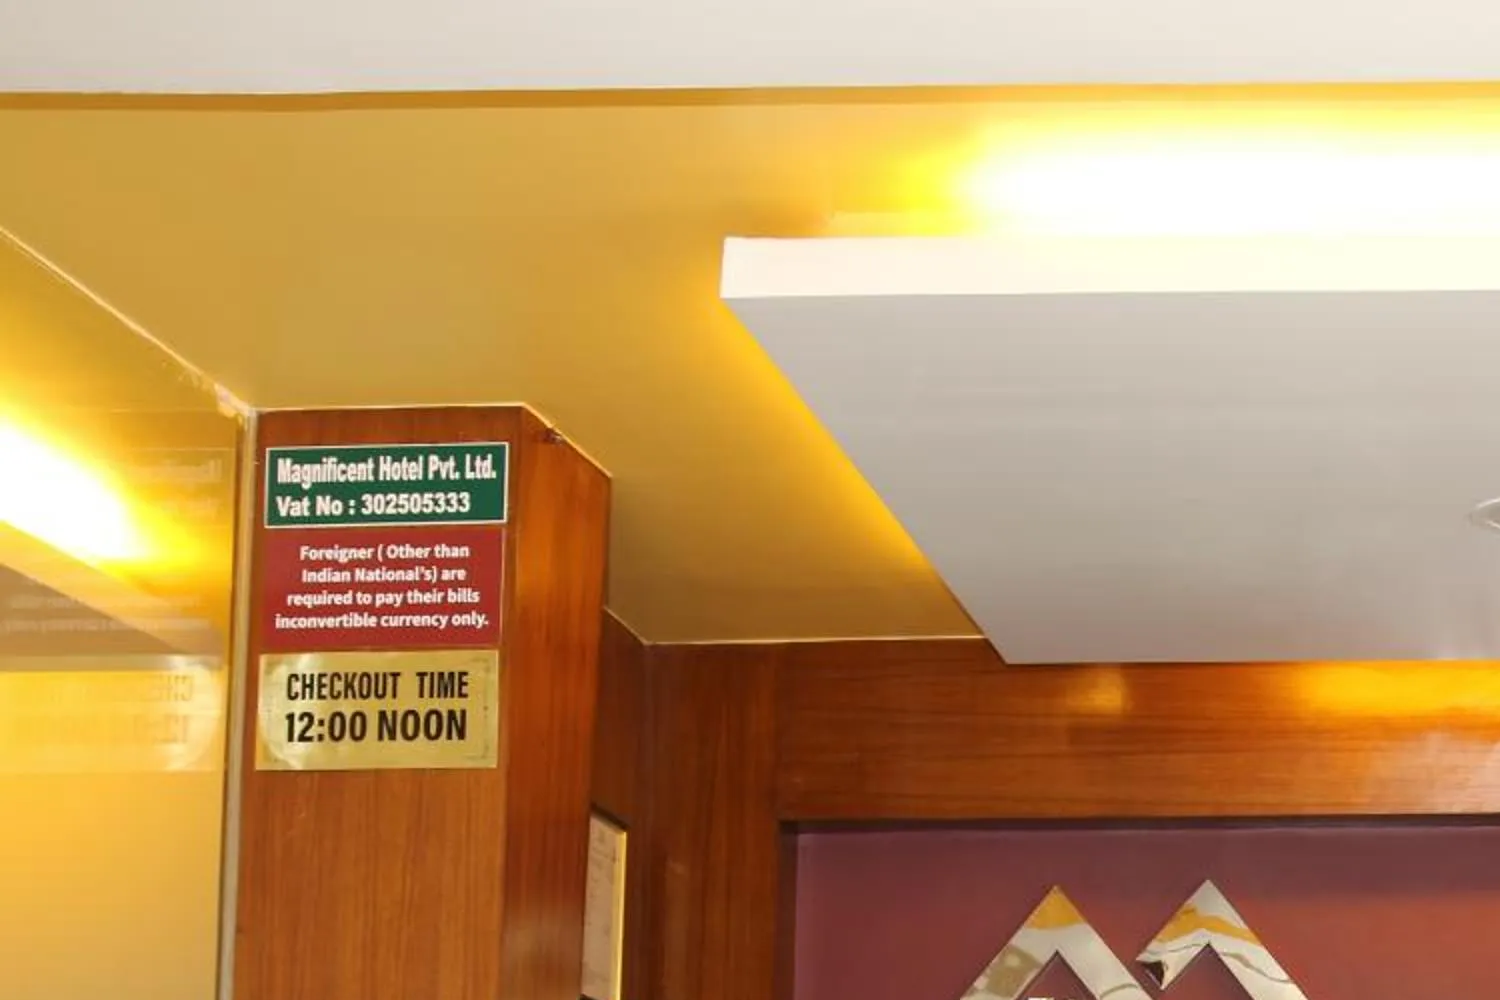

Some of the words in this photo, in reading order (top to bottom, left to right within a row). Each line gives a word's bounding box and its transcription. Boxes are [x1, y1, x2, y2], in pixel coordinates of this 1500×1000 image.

[277, 457, 374, 490] Magnificent
[379, 454, 423, 481] Hotel
[428, 454, 460, 480] Pvt.
[465, 453, 497, 479] Ltd.
[276, 496, 310, 517] Vat
[315, 495, 344, 516] No
[361, 492, 471, 515] 302505333
[300, 544, 374, 562] Foreigner
[387, 544, 430, 560] Other
[434, 544, 470, 558] than
[302, 567, 351, 583] Indian
[441, 568, 466, 581] are
[287, 590, 352, 608] required
[356, 590, 372, 605] to
[375, 592, 403, 607] pay
[407, 588, 444, 604] their
[447, 588, 480, 603] bills
[275, 611, 377, 629] inconvertible
[380, 613, 449, 629] currency
[452, 611, 489, 629] only.
[286, 671, 401, 700] CHECKOUT
[416, 671, 469, 699] TIME
[285, 710, 368, 743] 12:00
[377, 709, 467, 741] NOON
